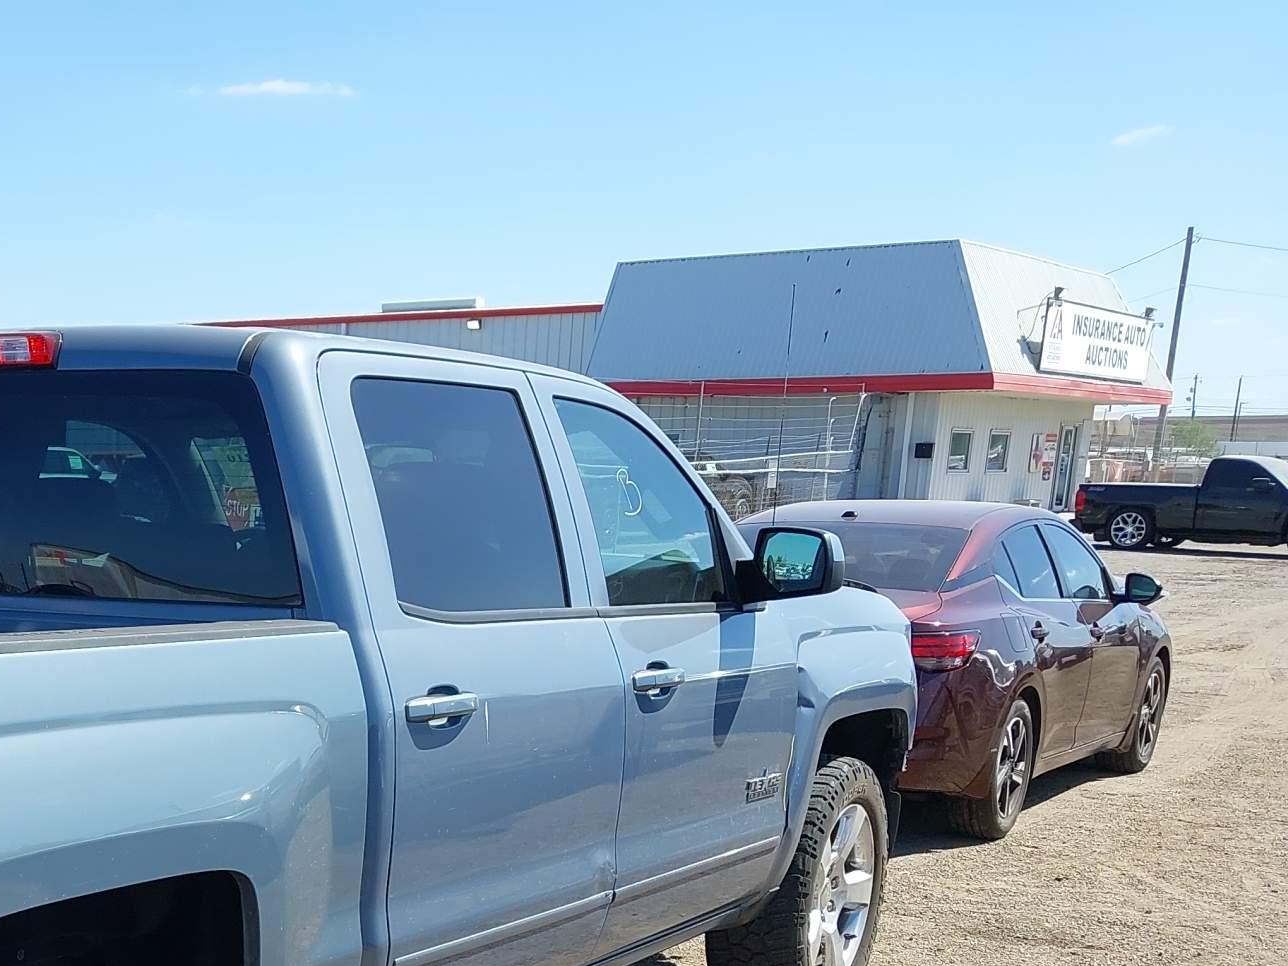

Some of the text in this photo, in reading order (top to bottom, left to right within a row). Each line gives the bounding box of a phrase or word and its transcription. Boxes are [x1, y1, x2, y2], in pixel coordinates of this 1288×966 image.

[1071, 313, 1147, 347] INSURANCE AUTO
[1084, 343, 1129, 370] AUCTIONS
[225, 498, 250, 518] STOP
